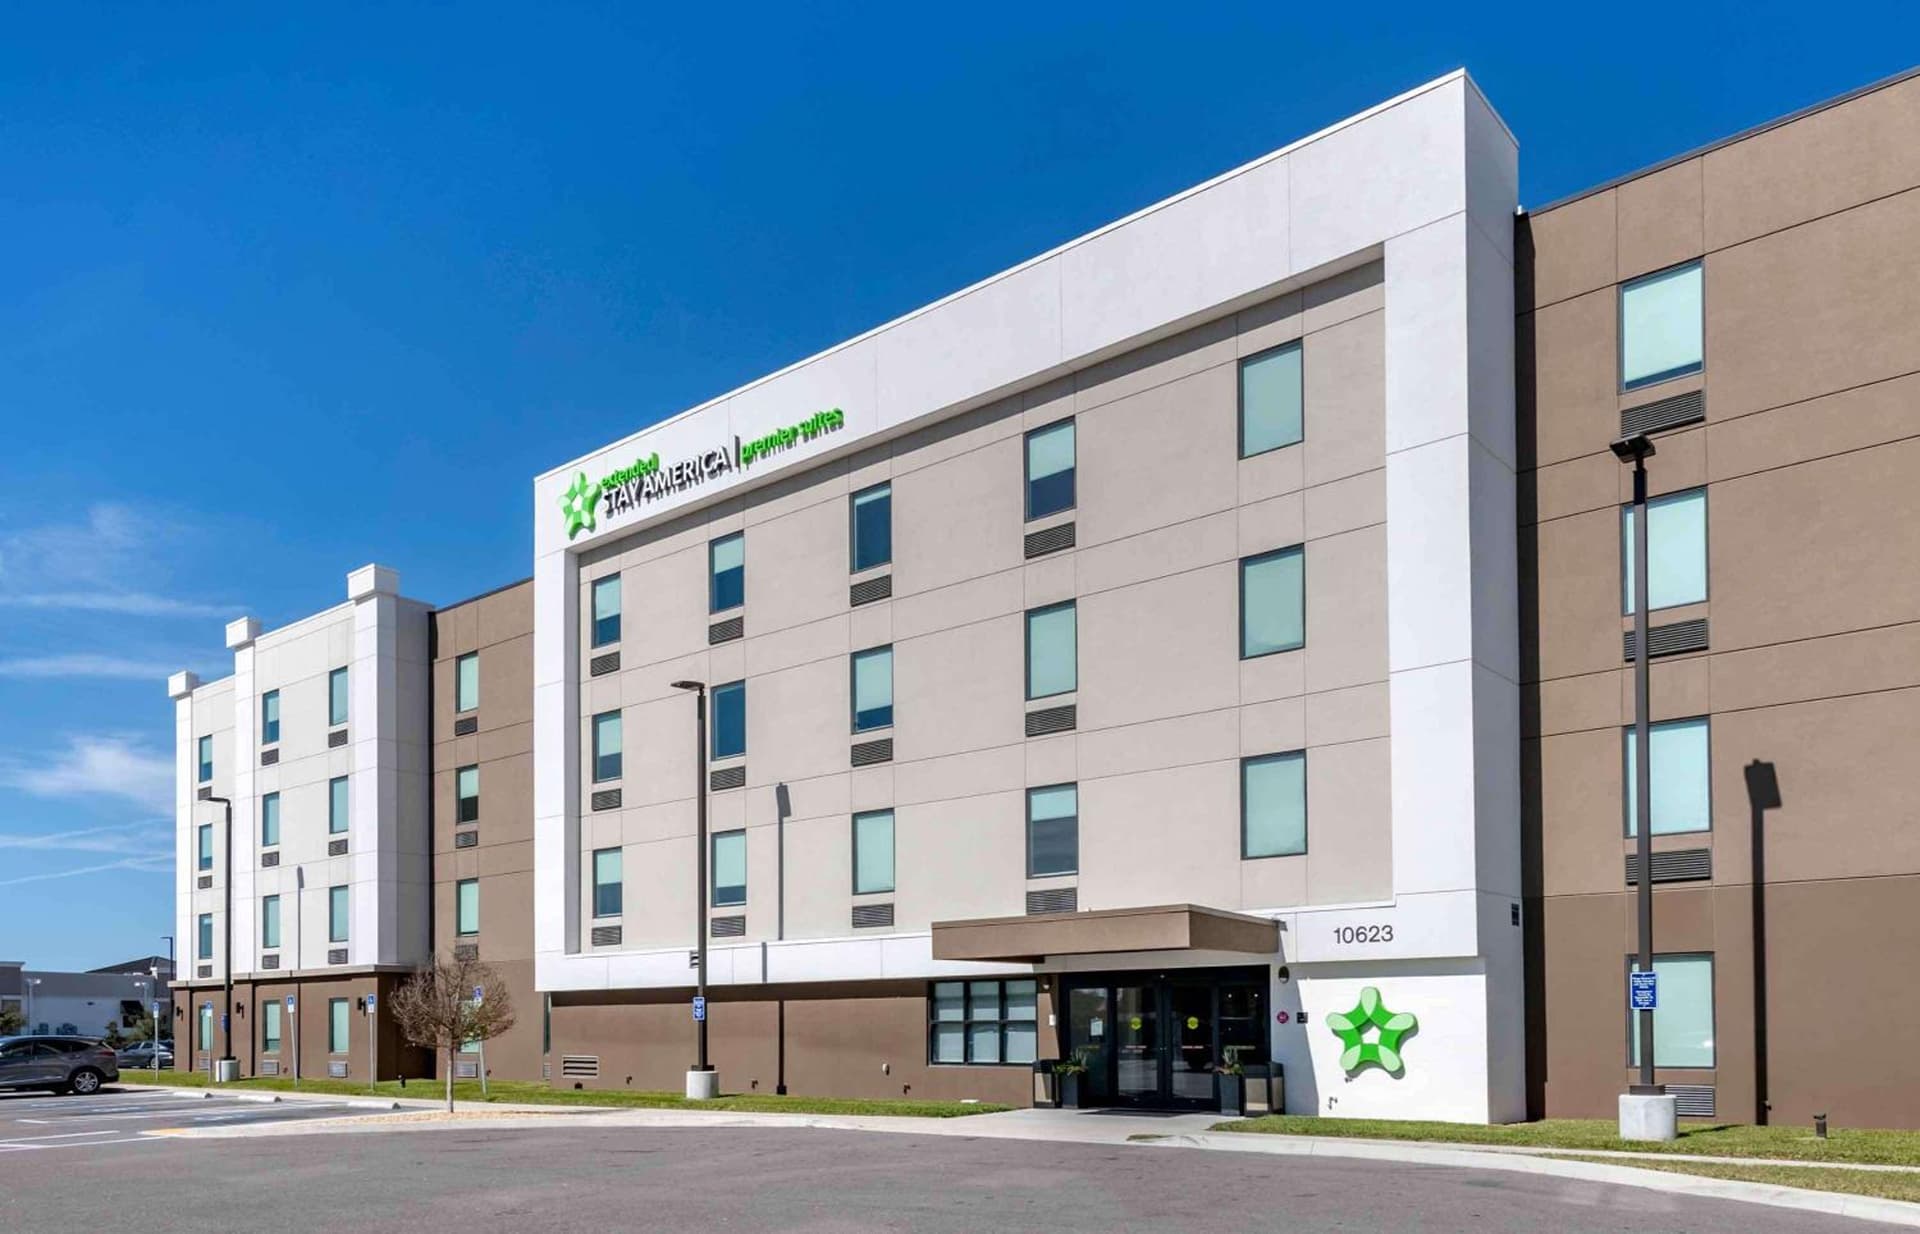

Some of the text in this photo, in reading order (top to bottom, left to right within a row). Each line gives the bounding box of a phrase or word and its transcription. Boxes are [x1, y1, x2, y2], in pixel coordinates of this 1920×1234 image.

[742, 407, 845, 465] premier suites
[601, 452, 659, 489] extended
[601, 446, 731, 514] STAY AMERICA
[1333, 924, 1394, 945] 10623
